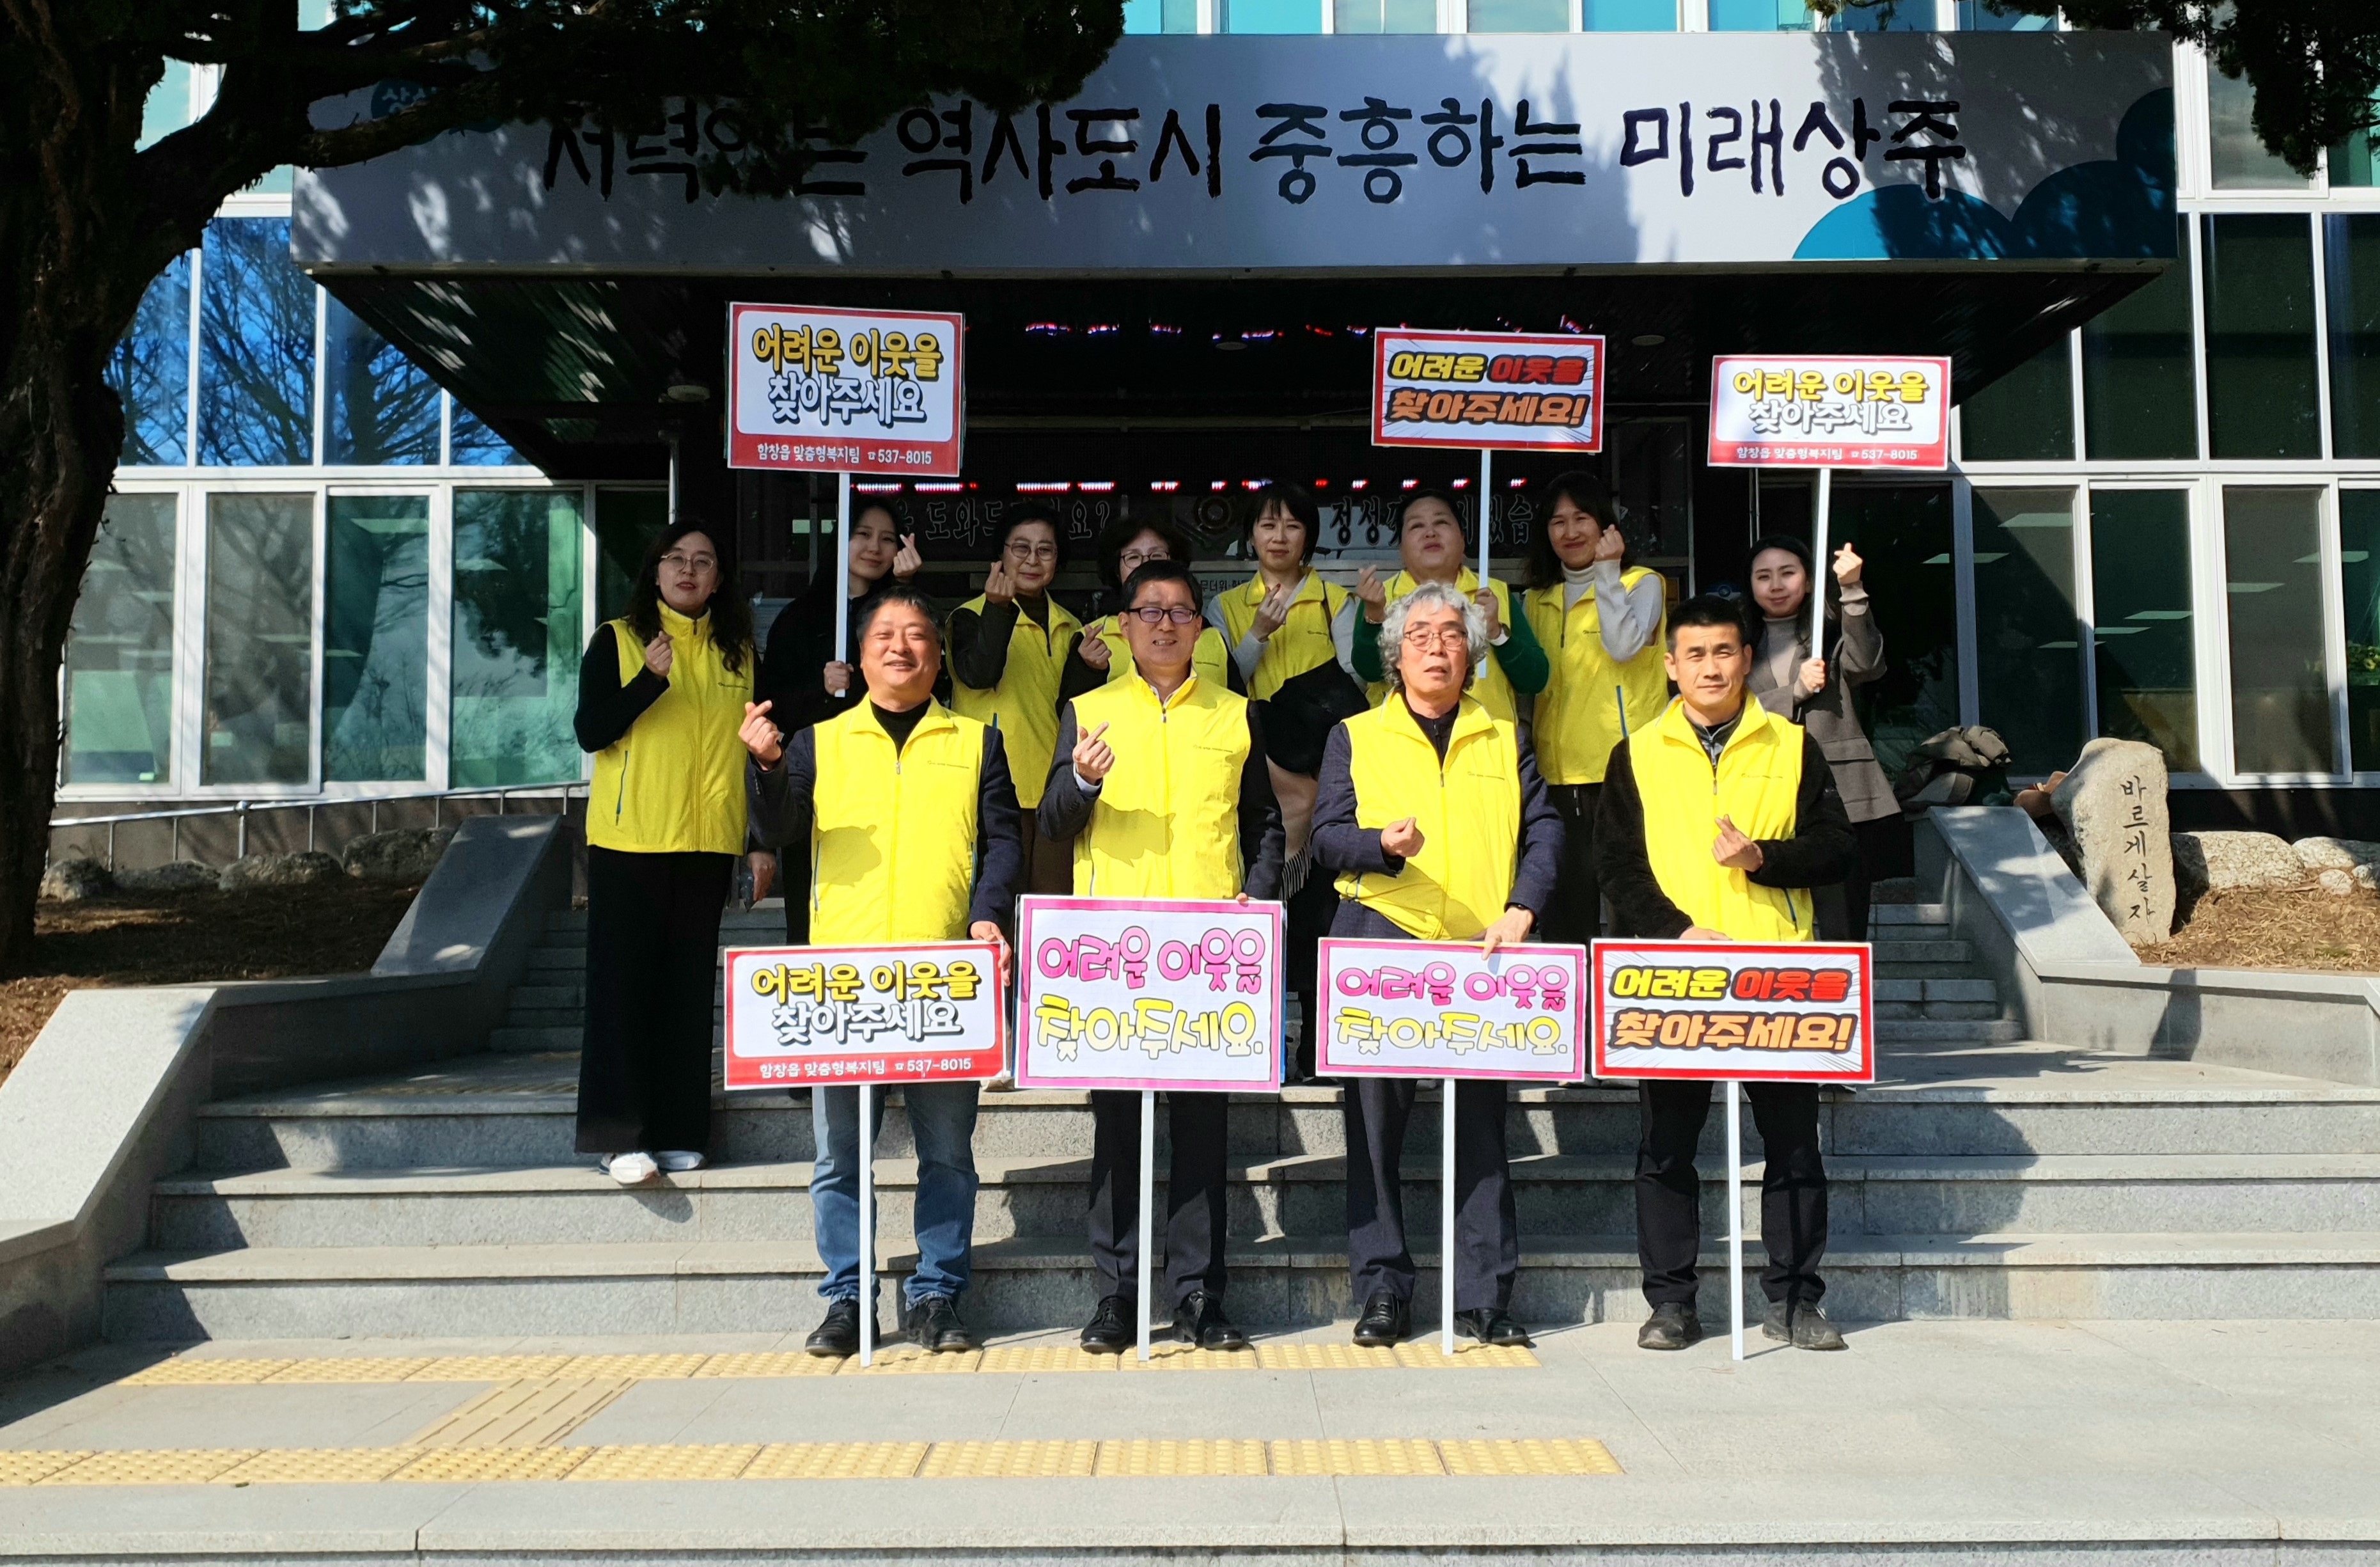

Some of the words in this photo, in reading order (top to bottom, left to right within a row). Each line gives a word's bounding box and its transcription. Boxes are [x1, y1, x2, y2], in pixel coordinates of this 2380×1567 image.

[896, 98, 1223, 203] 역사도시
[1249, 95, 1586, 205] 중흥하는
[1620, 97, 1966, 202] 미래상주
[751, 323, 843, 374] 어려운
[850, 329, 943, 381] 이웃을
[1389, 352, 1485, 382] 어려운
[1488, 355, 1587, 384] 이웃을
[769, 372, 927, 428] 찾아주세요
[1734, 368, 1827, 402] 어려운
[1834, 370, 1929, 404] 이웃을
[1388, 389, 1587, 427] 찾아주세요!
[1748, 399, 1912, 434] 찾아주세요
[757, 443, 790, 461] 함창읍
[794, 444, 860, 464] 맞춤형복지팀
[877, 448, 932, 465] 537-8015
[1736, 446, 1771, 459] 함창읍
[1774, 447, 1843, 461] 맞춤형복지팀
[1861, 448, 1918, 461] 537-8015
[1037, 925, 1151, 988] 어려운
[1157, 927, 1266, 995] 이웃을
[752, 963, 861, 1005] 어려운
[870, 961, 981, 1002] 이웃을
[1336, 961, 1457, 1006] 어려운
[1464, 963, 1570, 1012] 이웃을
[1609, 965, 1730, 1002] 어려운
[1731, 967, 1852, 1002] 이웃을
[773, 999, 964, 1046] 찾아주세요
[1609, 1009, 1855, 1054] 찾아주세요!
[759, 1062, 801, 1079] 함창읍
[804, 1059, 886, 1077] 맞춤형복지팀
[906, 1057, 973, 1073] 537-8015
